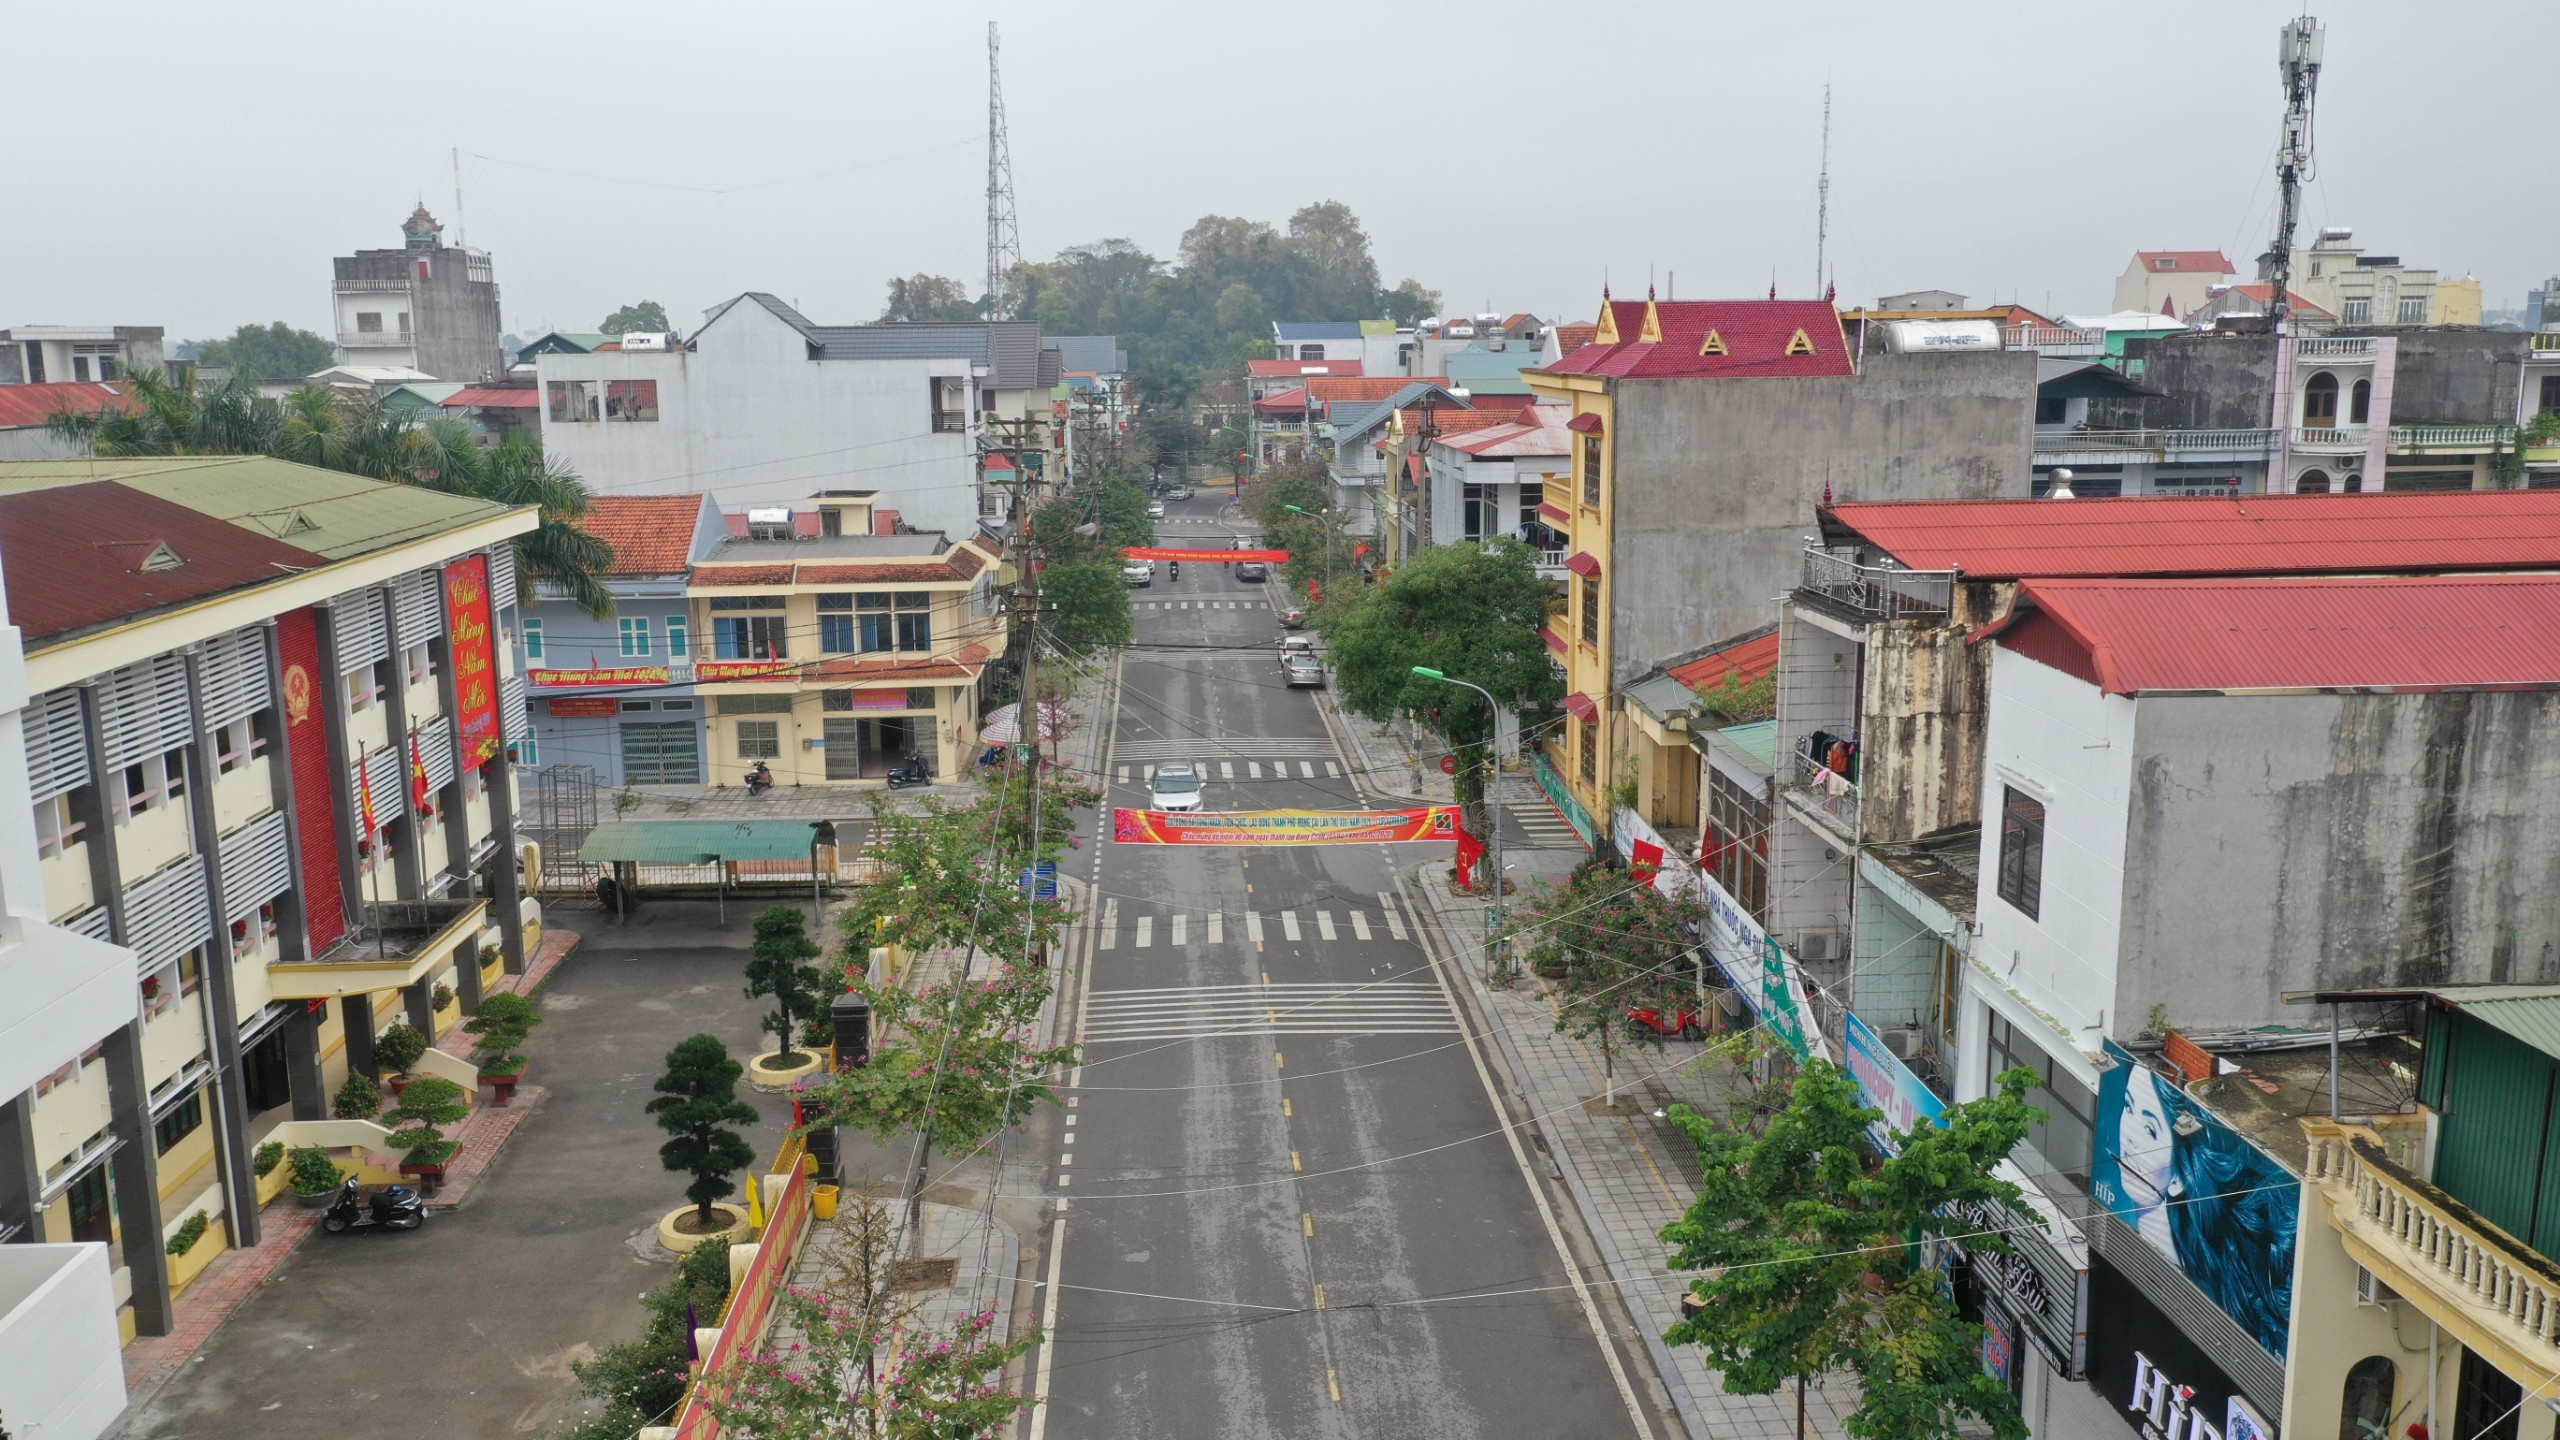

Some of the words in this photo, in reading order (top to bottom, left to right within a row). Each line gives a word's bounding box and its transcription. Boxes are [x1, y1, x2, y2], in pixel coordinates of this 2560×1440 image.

[451, 576, 479, 608] Chúc
[452, 611, 486, 646] Mừng
[456, 647, 487, 680] Năm
[463, 679, 487, 714] Mới
